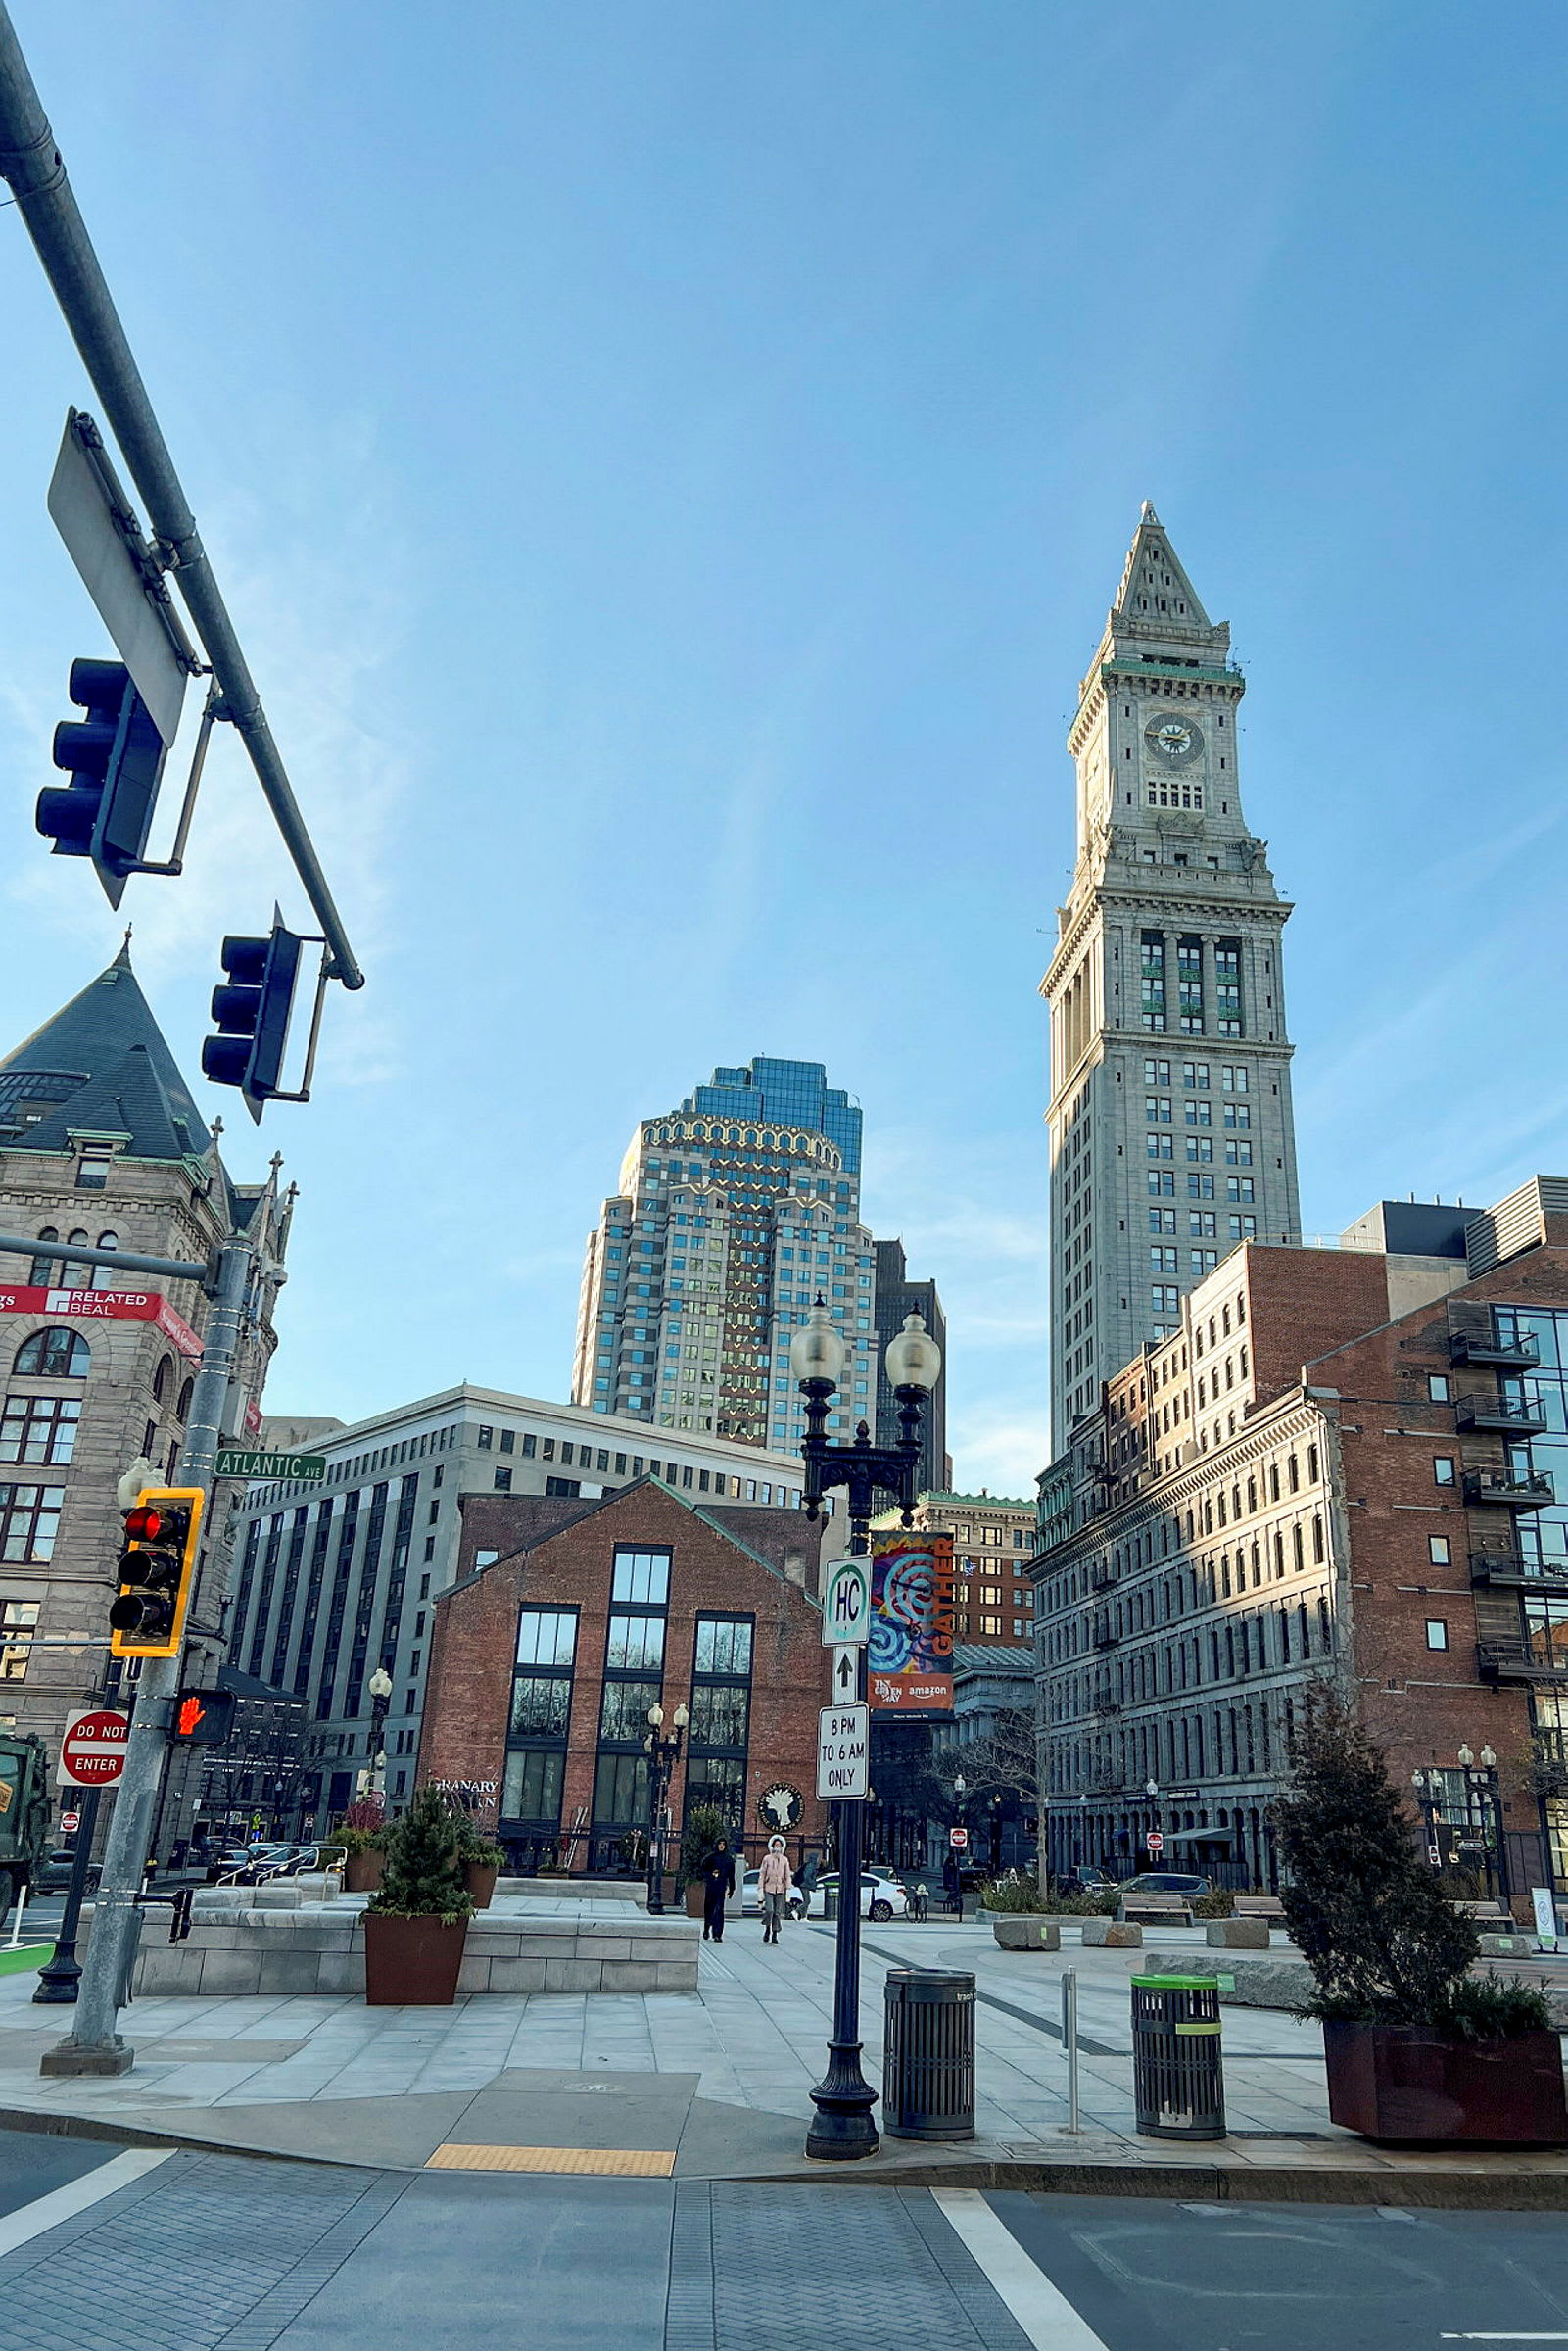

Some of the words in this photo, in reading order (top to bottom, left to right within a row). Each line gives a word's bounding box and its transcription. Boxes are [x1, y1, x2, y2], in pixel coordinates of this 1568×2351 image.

[71, 1292, 147, 1306] RELATED
[71, 1303, 115, 1316] BEAL
[219, 1453, 302, 1477] ATLANTIC
[304, 1467, 321, 1478] AVE
[835, 1578, 860, 1622] HC
[933, 1537, 954, 1656] GATHER
[908, 1686, 947, 1697] amazon
[77, 1725, 95, 1738] DO
[102, 1726, 127, 1739] NOT
[831, 1718, 838, 1736] 8
[840, 1716, 856, 1735] PM
[822, 1745, 834, 1762] TO
[838, 1744, 845, 1761] 6
[848, 1742, 865, 1760] AM
[75, 1758, 118, 1771] ENTER
[829, 1768, 855, 1788] ONLY
